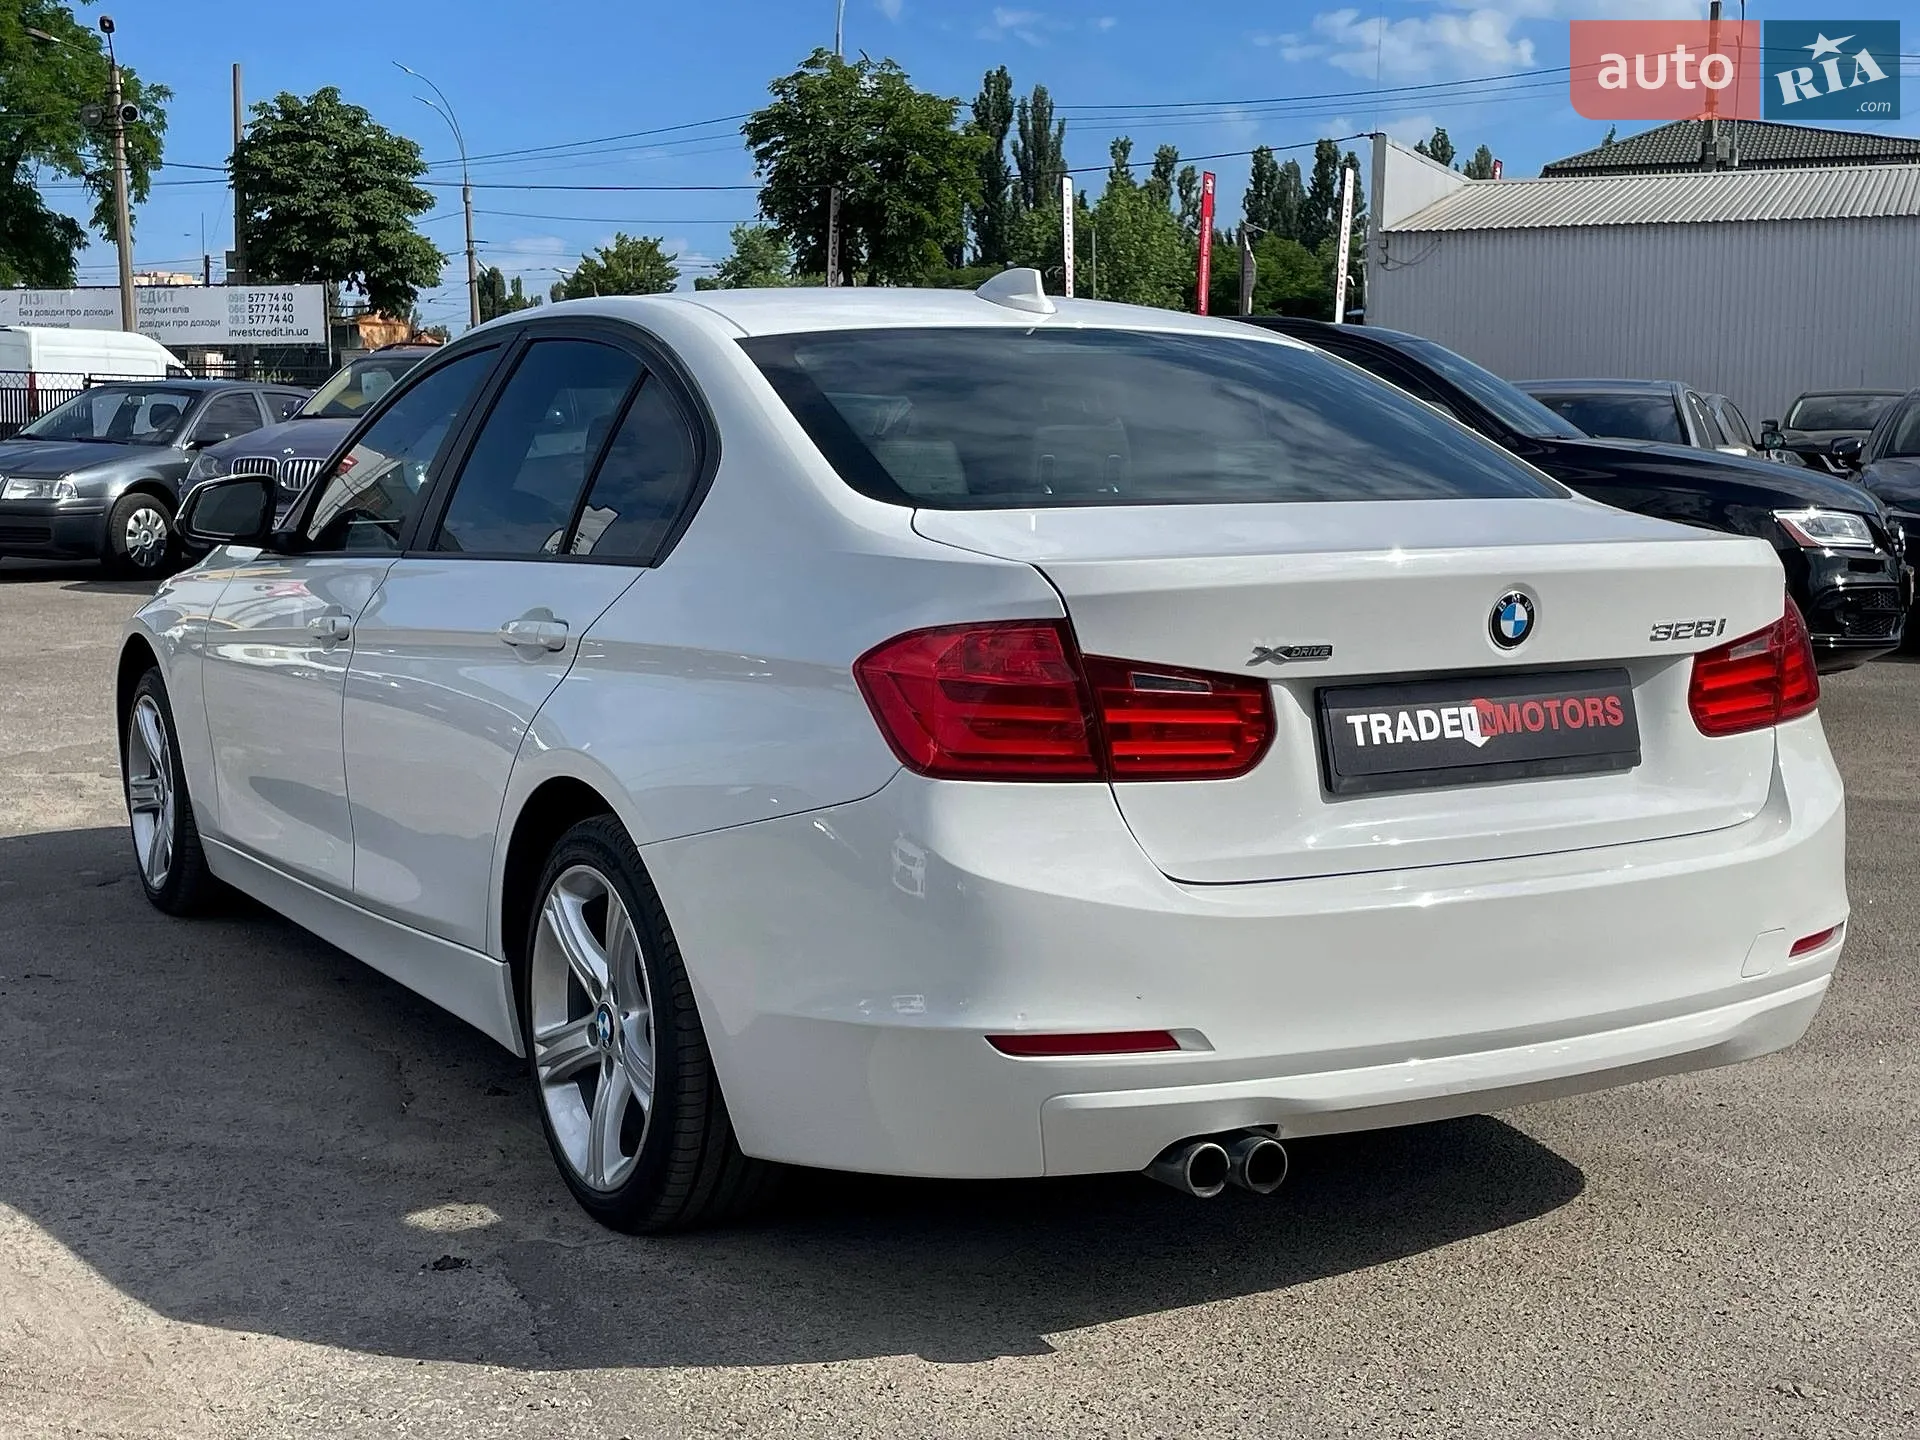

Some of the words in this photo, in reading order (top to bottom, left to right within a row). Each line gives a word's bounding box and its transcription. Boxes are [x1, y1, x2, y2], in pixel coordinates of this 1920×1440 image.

[248, 293, 266, 303] 577
[268, 293, 280, 303] 74
[281, 292, 294, 302] 40
[66, 308, 82, 318] про
[83, 308, 114, 317] доходи
[138, 306, 190, 315] поручителів
[248, 304, 266, 314] 577
[268, 304, 280, 314] 74
[281, 303, 294, 313] 40
[139, 319, 171, 328] довідки
[172, 320, 188, 328] про
[190, 319, 221, 329] доходи
[248, 315, 267, 325] 577
[268, 315, 280, 325] 74
[282, 314, 295, 324] 40
[228, 326, 309, 337] investcredit.in.ua
